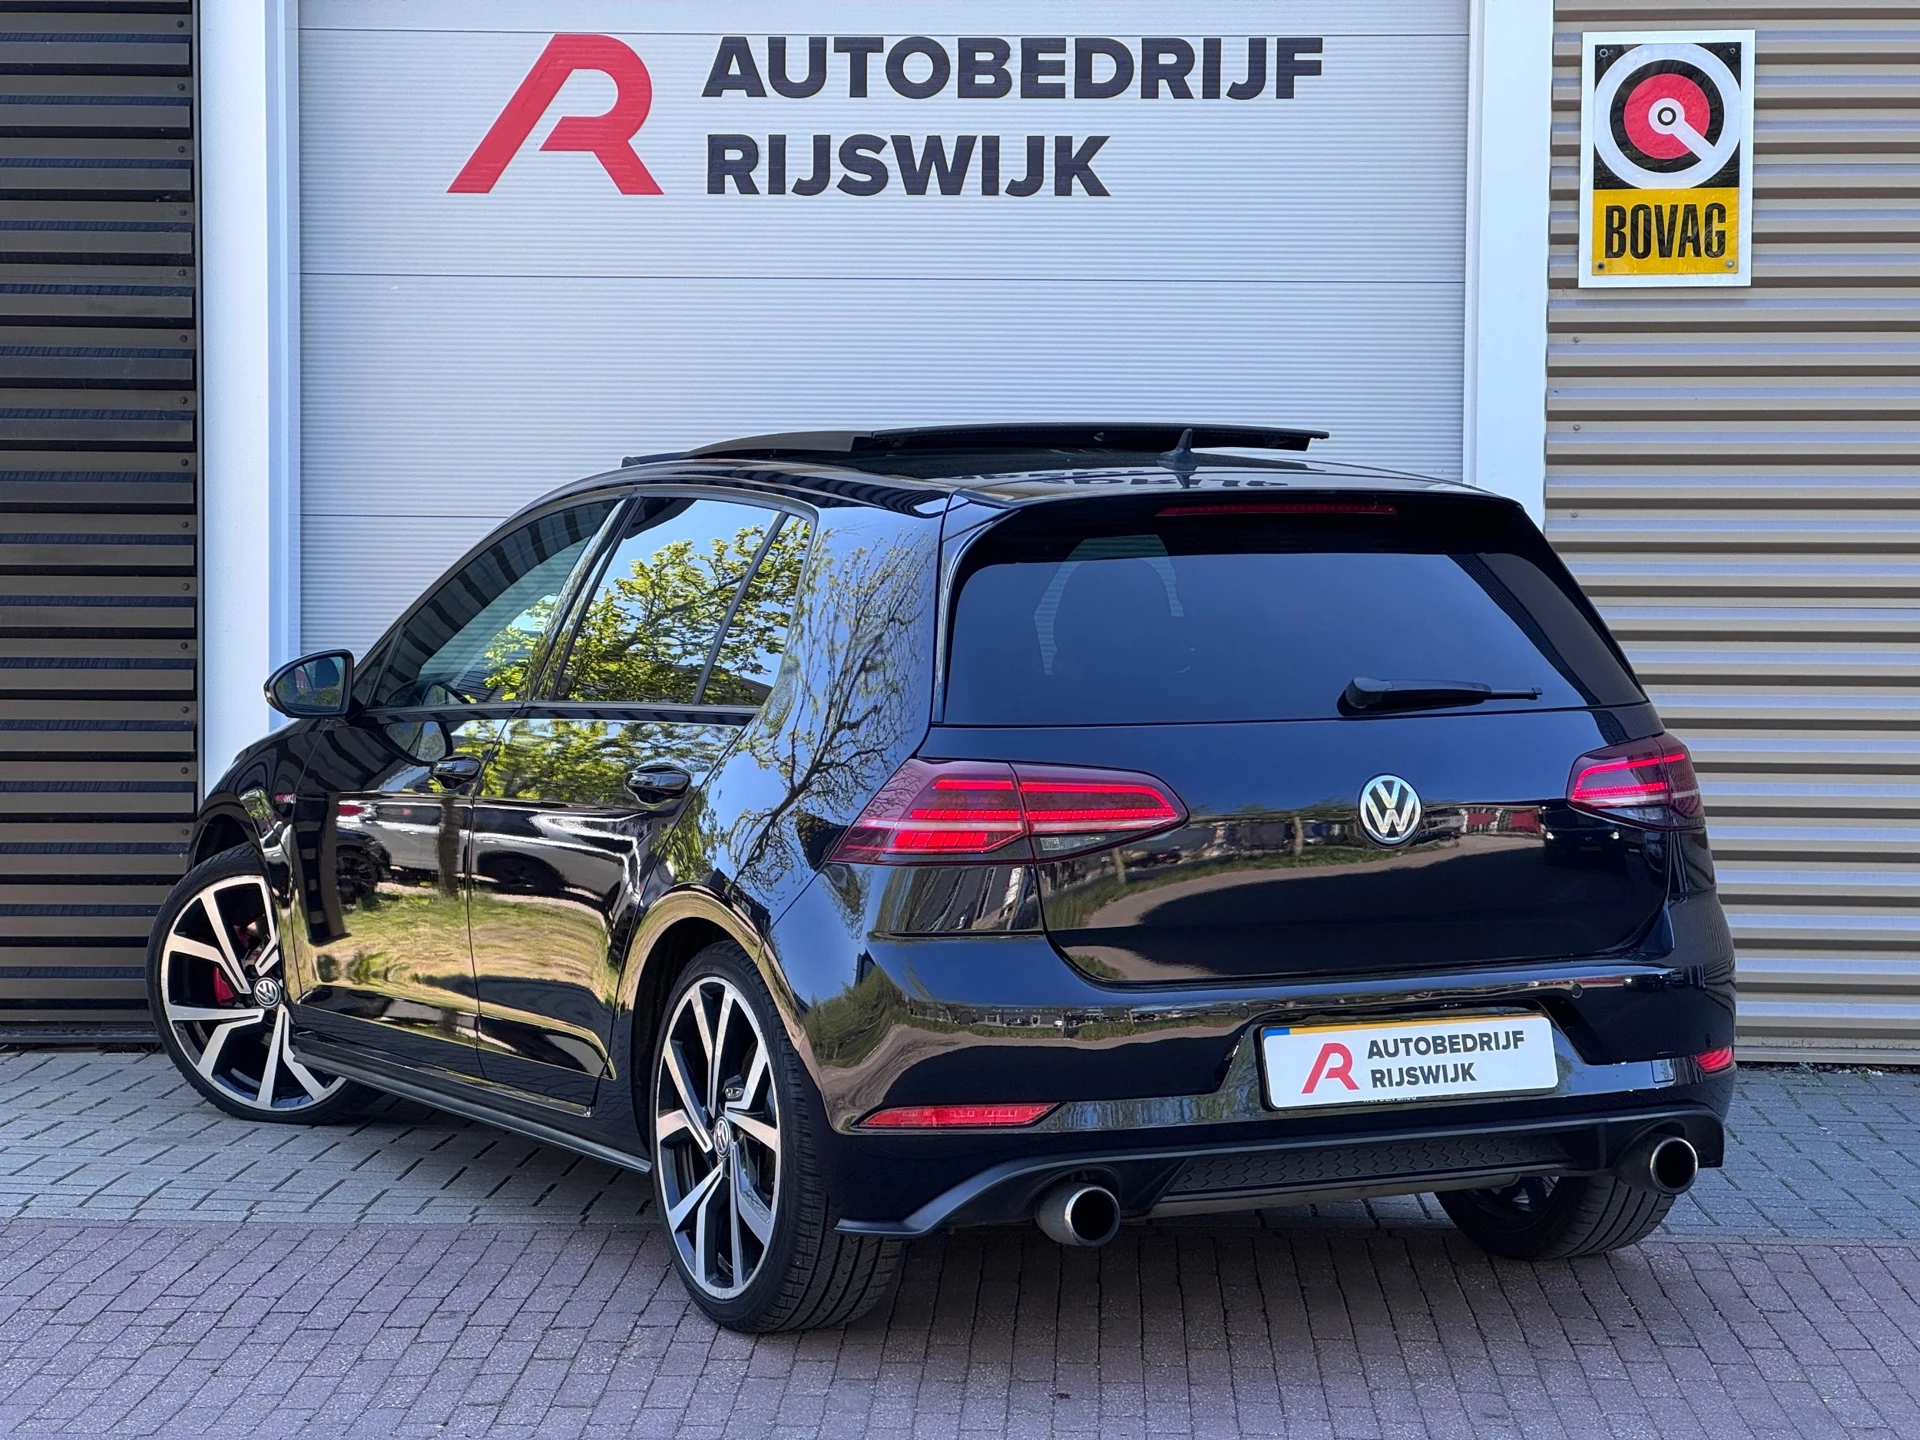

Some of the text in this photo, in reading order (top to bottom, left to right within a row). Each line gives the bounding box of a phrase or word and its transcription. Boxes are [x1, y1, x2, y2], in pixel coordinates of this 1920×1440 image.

[702, 36, 1324, 101] AUTOBEDRIJF
[707, 133, 1112, 198] RIJSWIJK
[1604, 203, 1727, 260] BOVAG
[1367, 1030, 1524, 1059] AUTOBEDRIJF
[1370, 1063, 1476, 1088] RIJSWIJK
